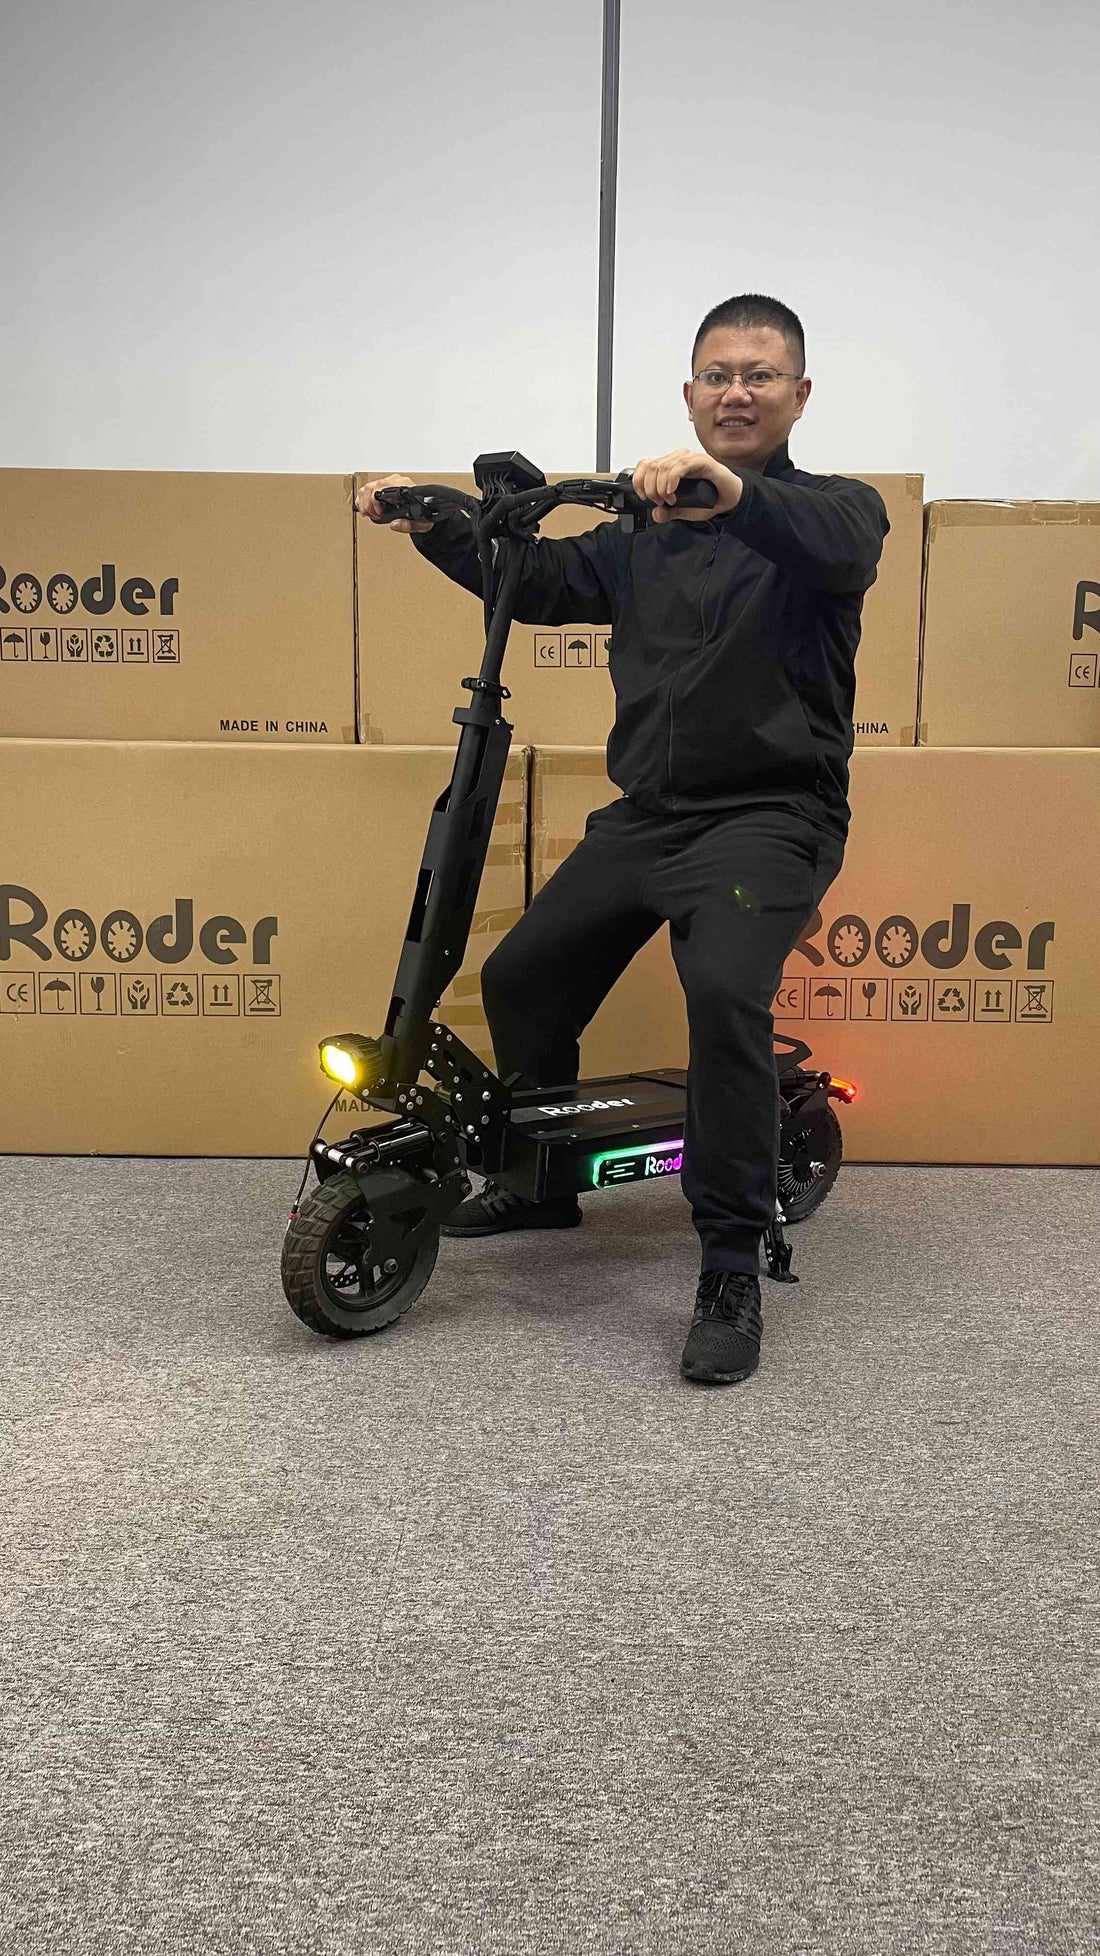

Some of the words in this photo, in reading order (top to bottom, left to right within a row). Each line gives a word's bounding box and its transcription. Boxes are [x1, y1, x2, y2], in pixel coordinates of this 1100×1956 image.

[0, 564, 179, 615] ooder
[220, 720, 259, 731] MADE
[265, 721, 278, 731] IN
[285, 721, 328, 732] CHINA
[853, 722, 889, 733] HINA
[0, 884, 278, 965] Rooder
[537, 1098, 636, 1117] Rooder
